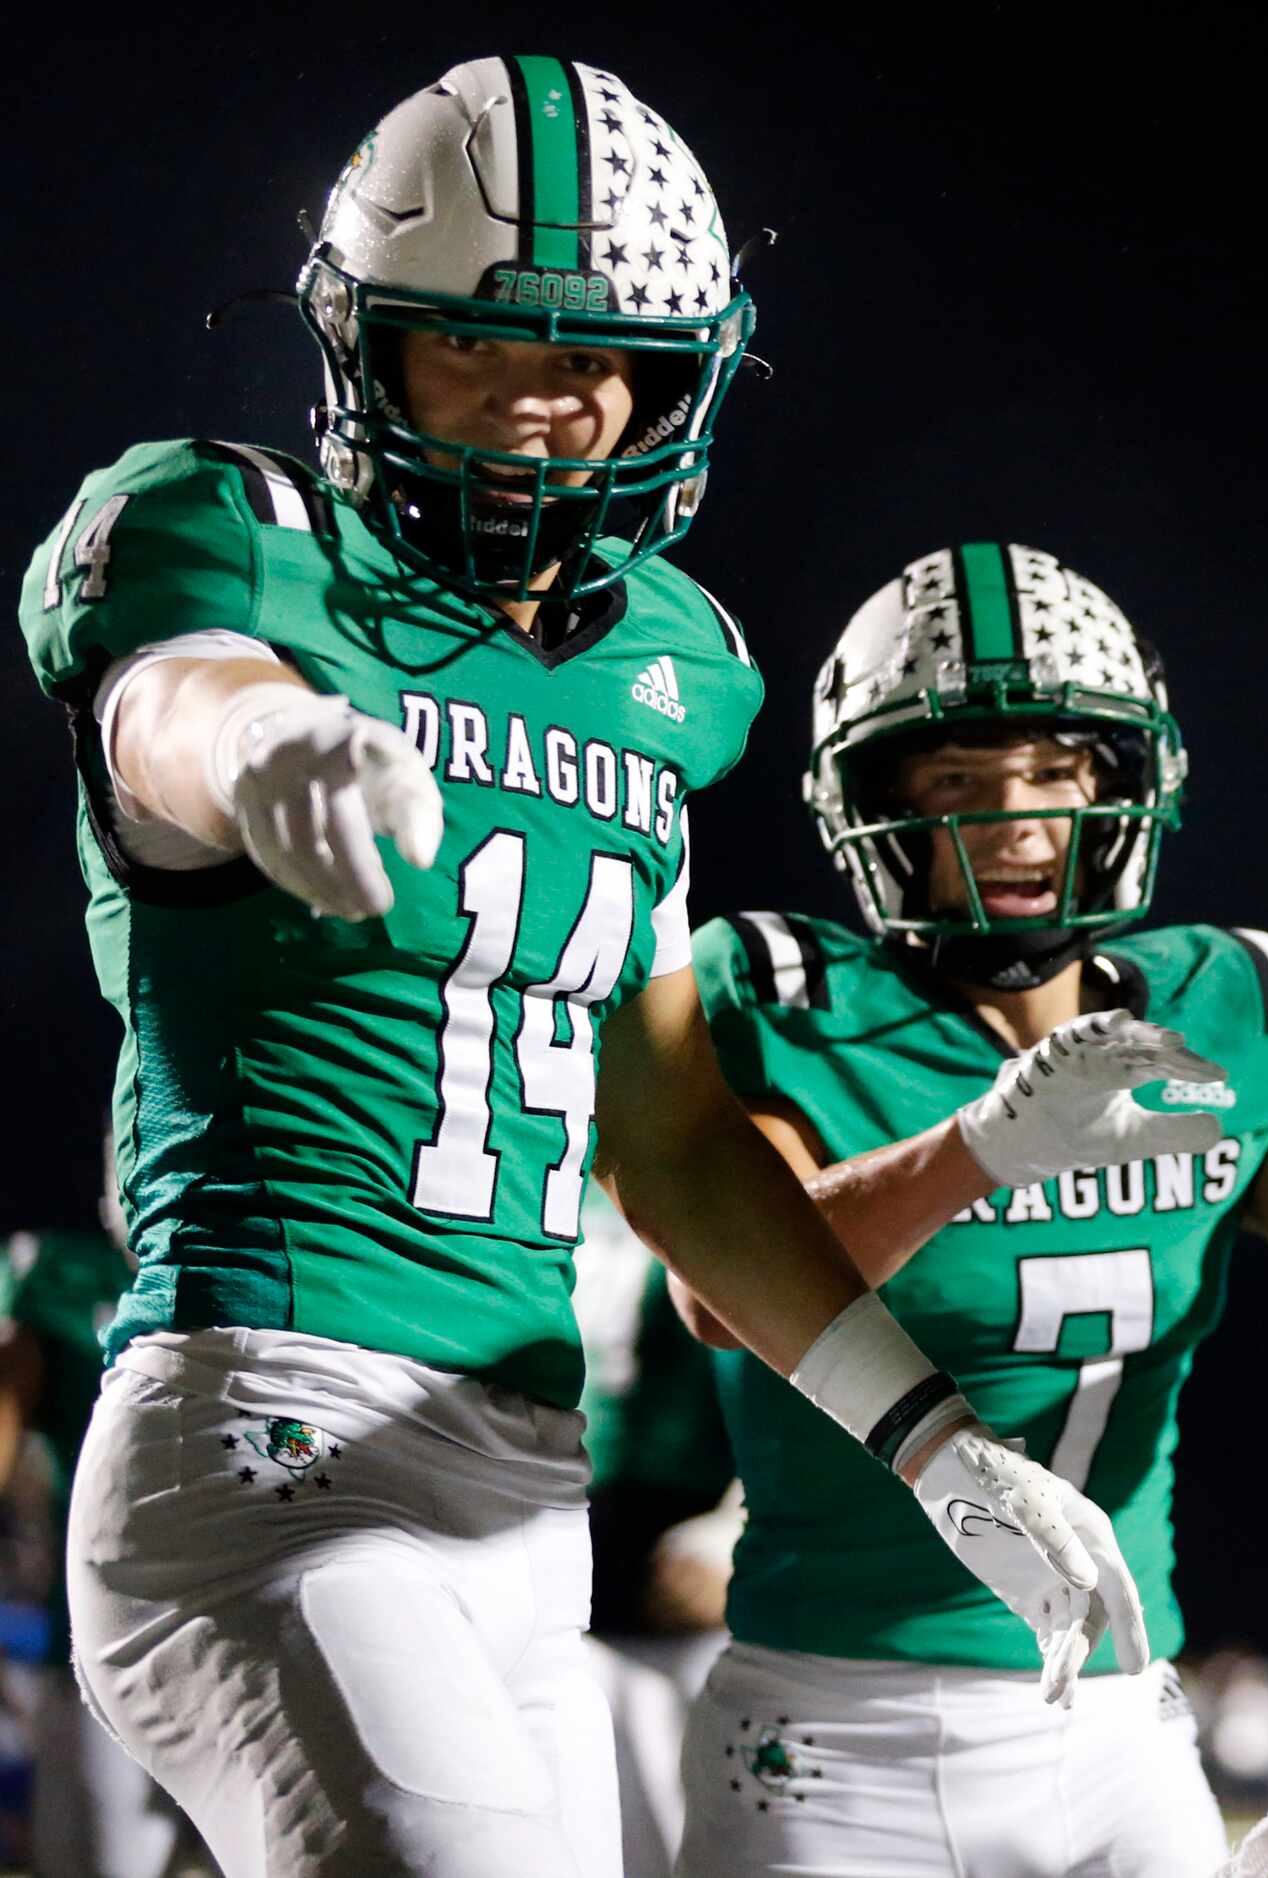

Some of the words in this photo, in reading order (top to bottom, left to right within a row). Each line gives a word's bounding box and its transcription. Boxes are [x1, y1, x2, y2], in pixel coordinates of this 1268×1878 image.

[494, 269, 609, 312] 76092
[43, 492, 137, 613] 14
[631, 683, 687, 723] adidas
[399, 689, 678, 848] DRAGONS
[407, 825, 635, 1243] 14
[950, 1136, 1242, 1224] AGONS
[1012, 1246, 1156, 1492] 7
